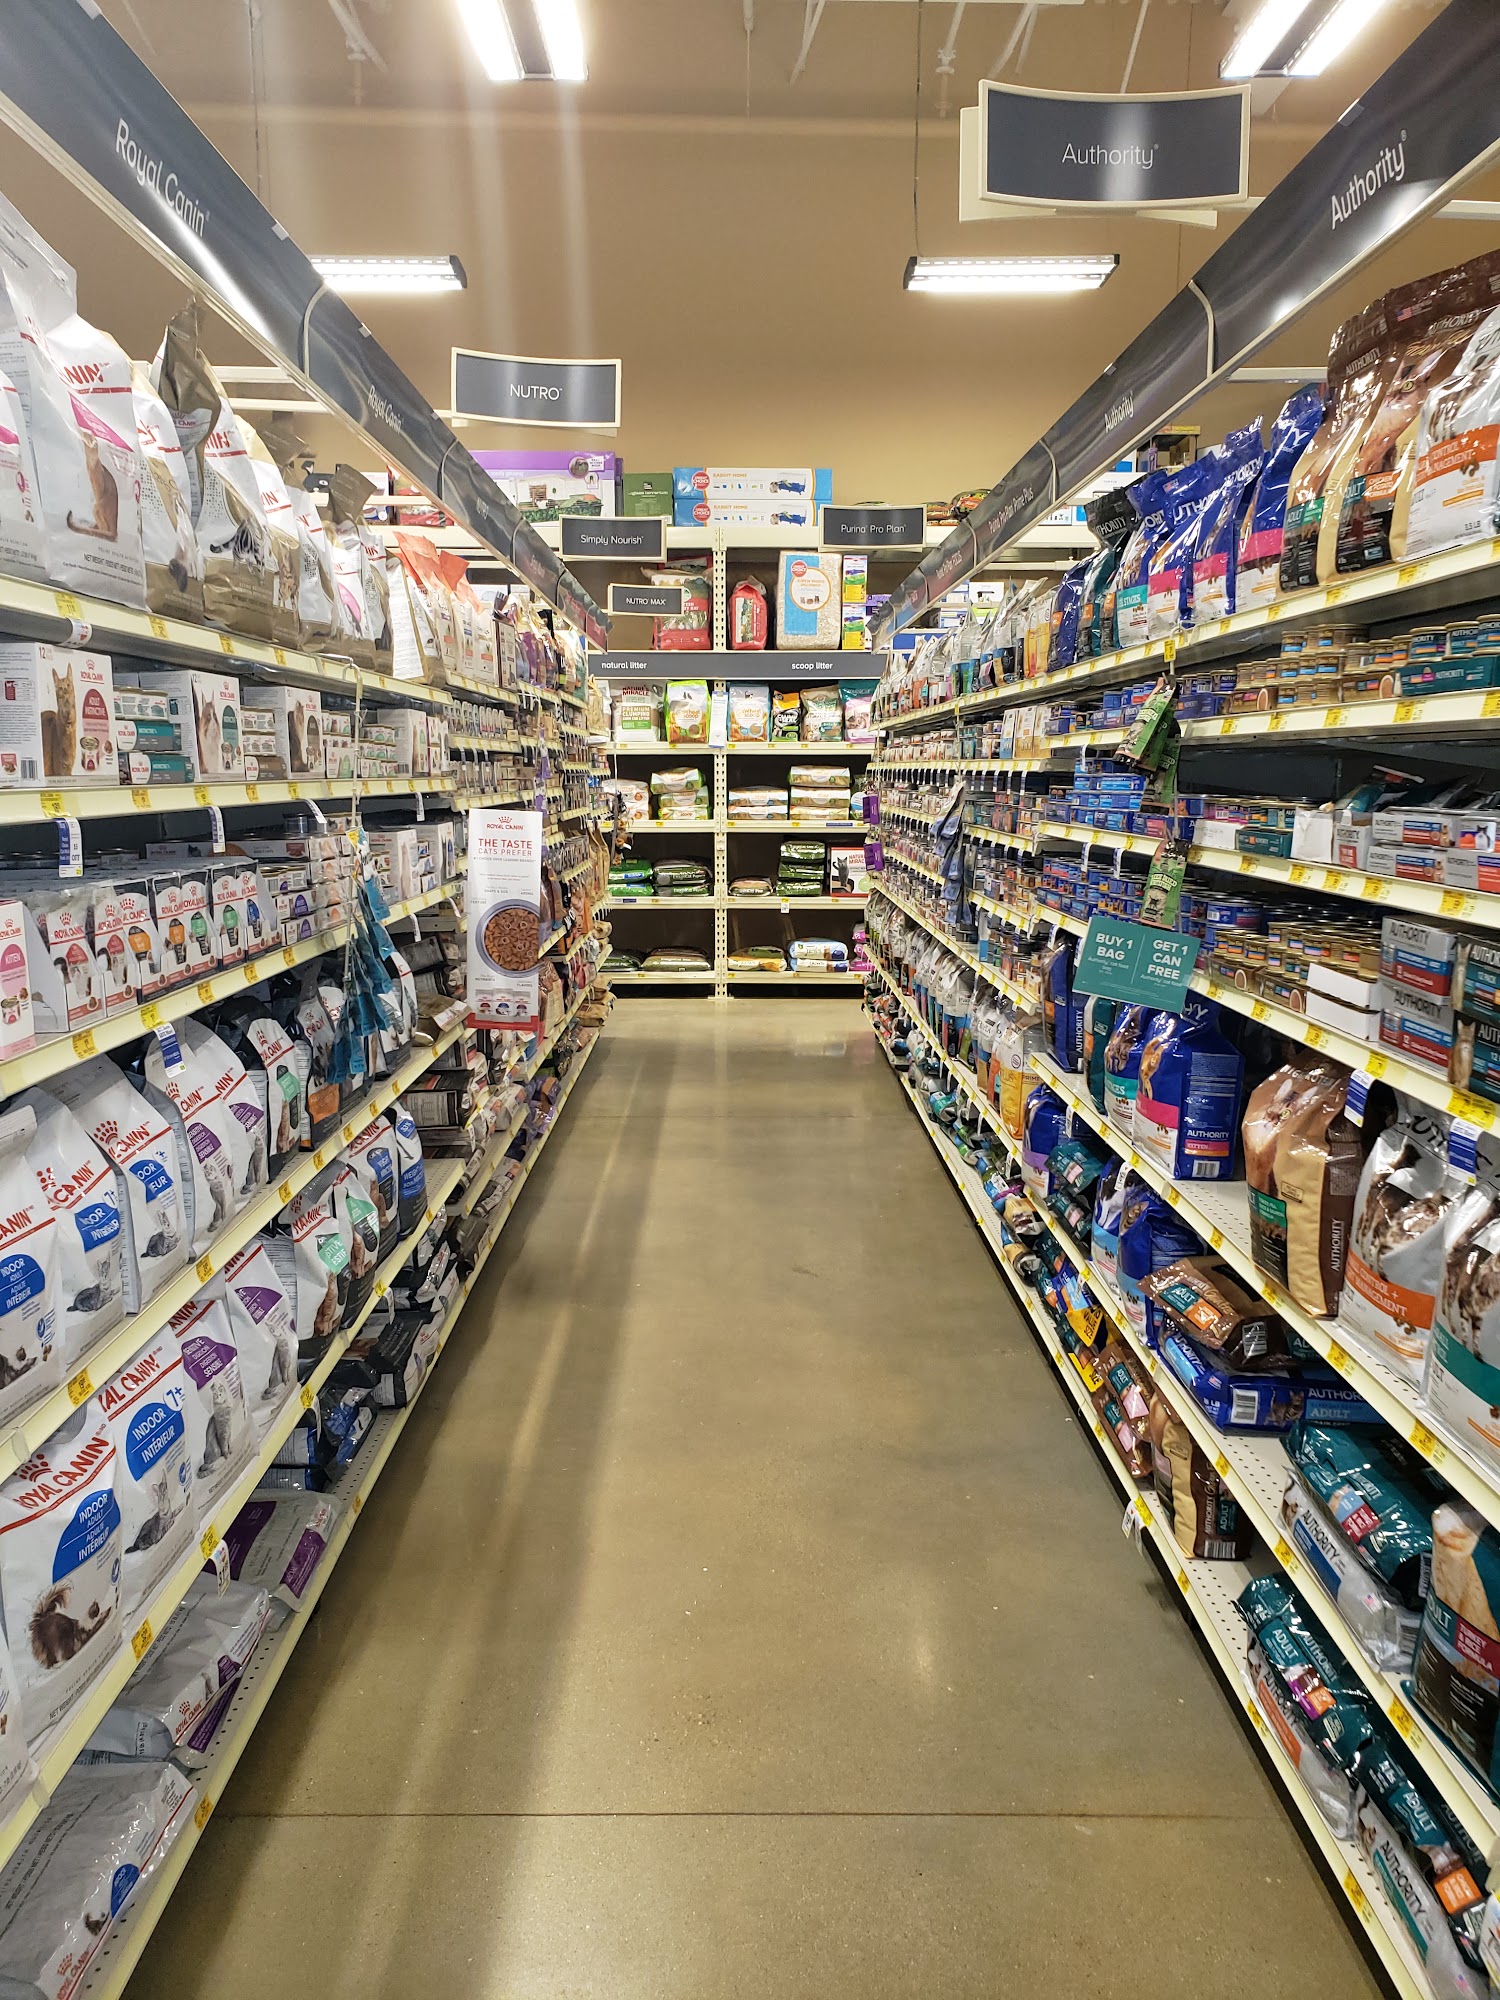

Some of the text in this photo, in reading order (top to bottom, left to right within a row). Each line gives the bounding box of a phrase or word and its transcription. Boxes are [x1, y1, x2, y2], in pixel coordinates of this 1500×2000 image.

[115, 118, 163, 197] Royal
[1345, 346, 1381, 377] AUTHORITY
[580, 535, 642, 545] Simply Nourish
[870, 525, 884, 534] Pro
[886, 524, 905, 534] Plan
[626, 597, 648, 605] NUTRO
[39, 647, 46, 660] 12
[601, 661, 648, 669] natural litter
[791, 662, 833, 671] scoop litter
[478, 838, 533, 849] THE TASTE
[478, 847, 498, 855] CATS
[1096, 933, 1134, 950] BUY 1
[1390, 921, 1430, 945] AUTHORITY
[1096, 947, 1125, 960] BAG
[1153, 939, 1188, 956] GET 1
[1470, 944, 1500, 963] AUTHOR
[1153, 953, 1182, 967] CAN
[1147, 964, 1181, 980] FREE
[1393, 989, 1442, 1019] AUTHORITY
[215, 1072, 235, 1092] NIN
[1186, 1130, 1229, 1139] AUTHORITY
[137, 1163, 157, 1180] OOR
[53, 1164, 95, 1203] CANIN
[0, 1209, 32, 1240] ANIN
[1331, 1218, 1343, 1272] AUTHORITY
[168, 1300, 198, 1331] ANIN
[98, 1353, 163, 1413] YAL CANIN
[1308, 1388, 1362, 1401] AUTHOR
[165, 1386, 182, 1408] 7+
[131, 1407, 167, 1441] INDOOR
[1310, 1408, 1350, 1418] ADULT
[141, 1424, 176, 1464] INTÉRIEUR
[59, 1435, 110, 1487] CANIN
[79, 1493, 109, 1524] INDOOR
[87, 1510, 104, 1528] ADULT
[1204, 1496, 1215, 1535] AUTHORITY
[1219, 1505, 1229, 1531] ADULT
[1300, 1509, 1340, 1562] AUTHORITY
[1427, 1596, 1452, 1636] DULT
[1272, 1628, 1299, 1660] ADULT
[1302, 1632, 1339, 1682] AUTHORITY
[1403, 1791, 1437, 1832] ADULT
[1379, 1839, 1427, 1916] AUTHORITY
